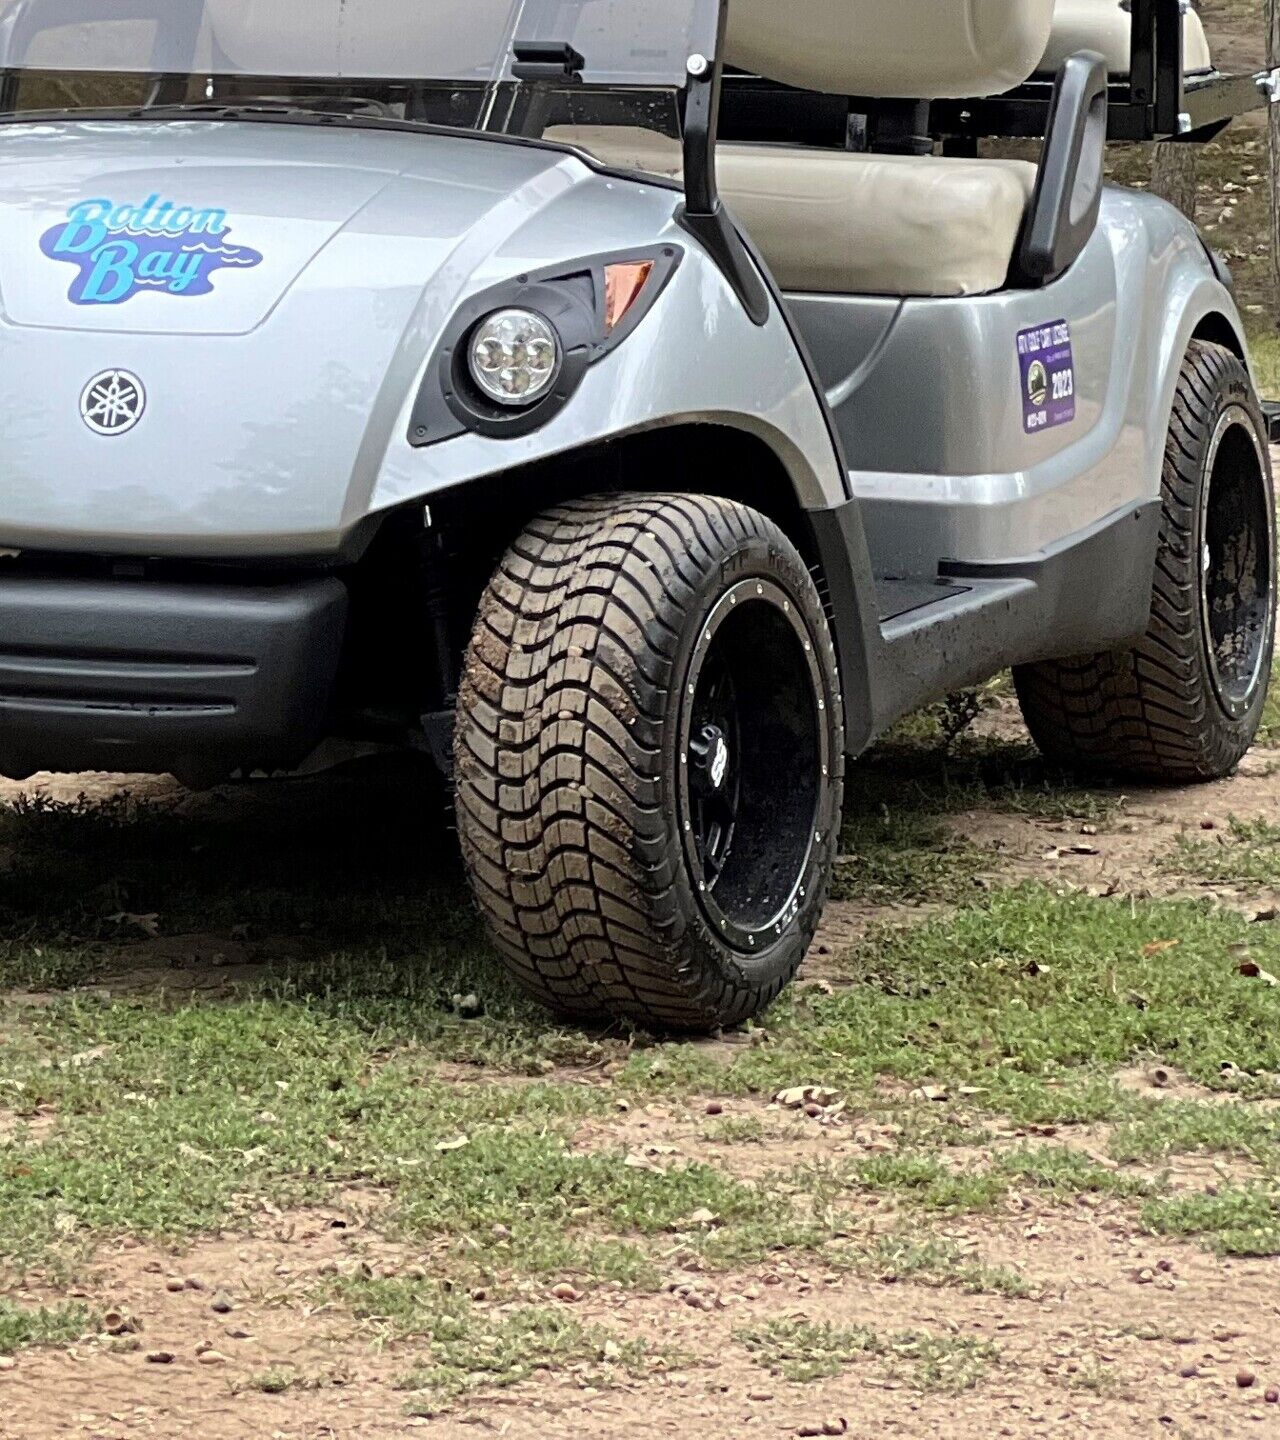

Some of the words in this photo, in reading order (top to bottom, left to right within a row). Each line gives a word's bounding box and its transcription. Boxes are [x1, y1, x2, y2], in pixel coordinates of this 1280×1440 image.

[52, 191, 227, 253] Bolton
[80, 239, 205, 302] Bay
[1051, 368, 1073, 400] 2023
